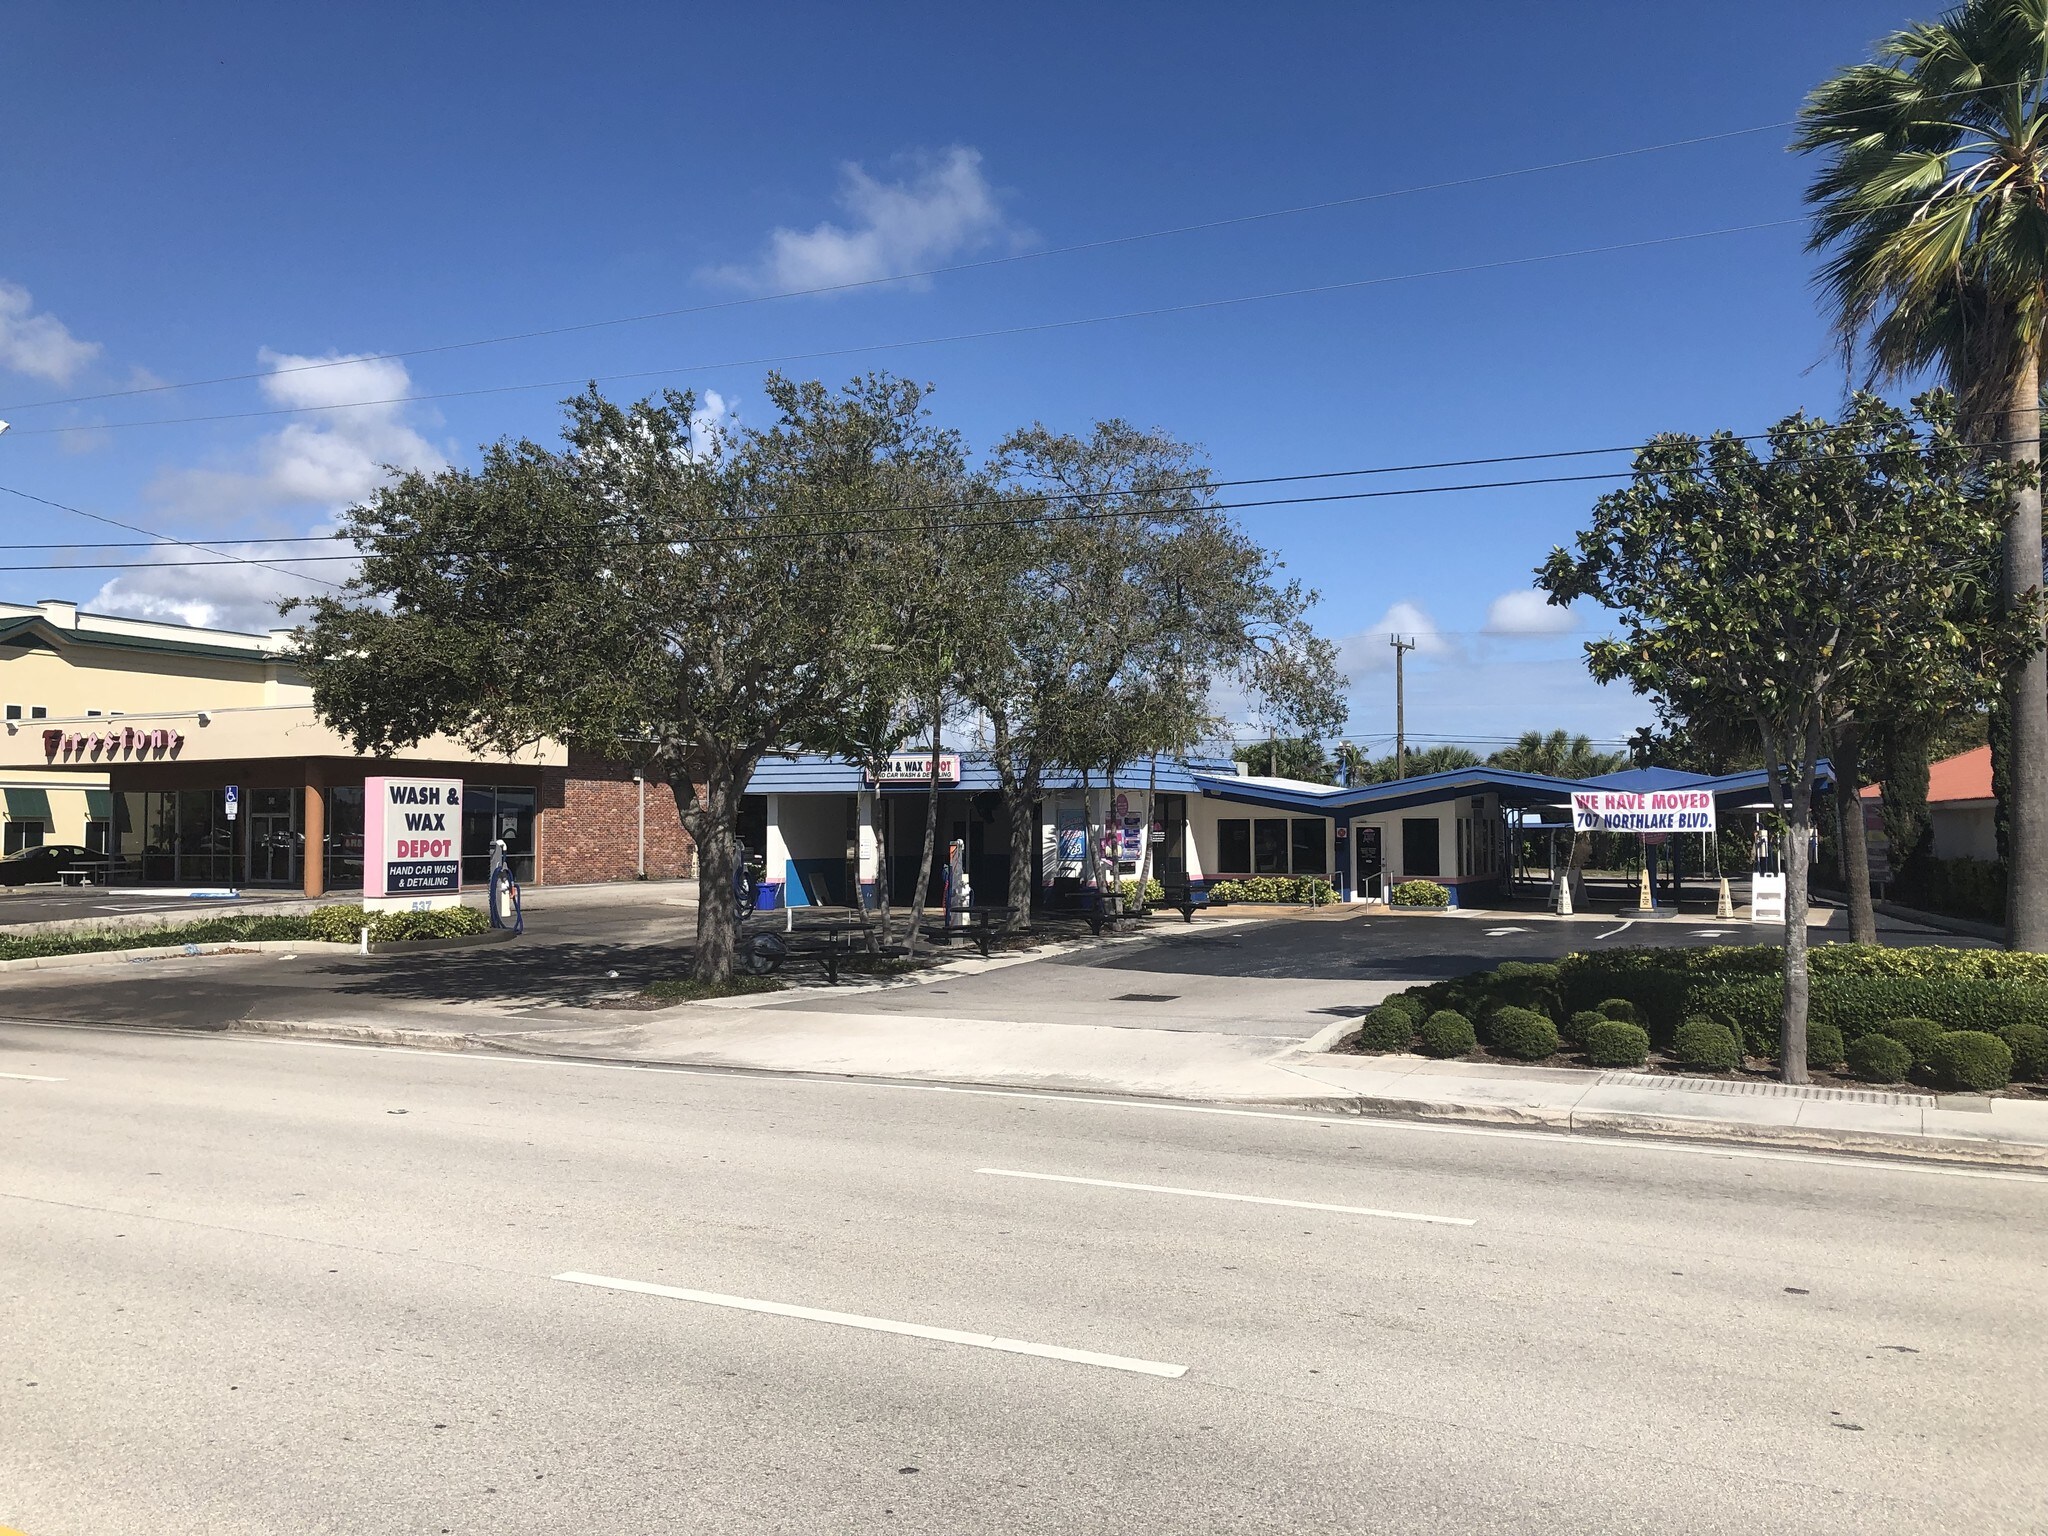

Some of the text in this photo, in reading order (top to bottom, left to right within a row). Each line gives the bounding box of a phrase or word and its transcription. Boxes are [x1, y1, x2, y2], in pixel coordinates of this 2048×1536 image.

[42, 727, 184, 758] Firestone
[896, 761, 902, 772] &
[905, 761, 923, 772] WAX
[926, 761, 952, 772] DOT
[390, 786, 460, 806] WASH &
[1574, 793, 1710, 810] WE HAVE MOVED
[405, 813, 445, 831] WAX
[1578, 812, 1712, 829] 707 NORTHLAKE BLVD.
[397, 839, 452, 858] DEPOT
[389, 864, 457, 876] HAND CAR WASH
[399, 877, 448, 888] & DETAILING
[412, 900, 432, 913] 537
